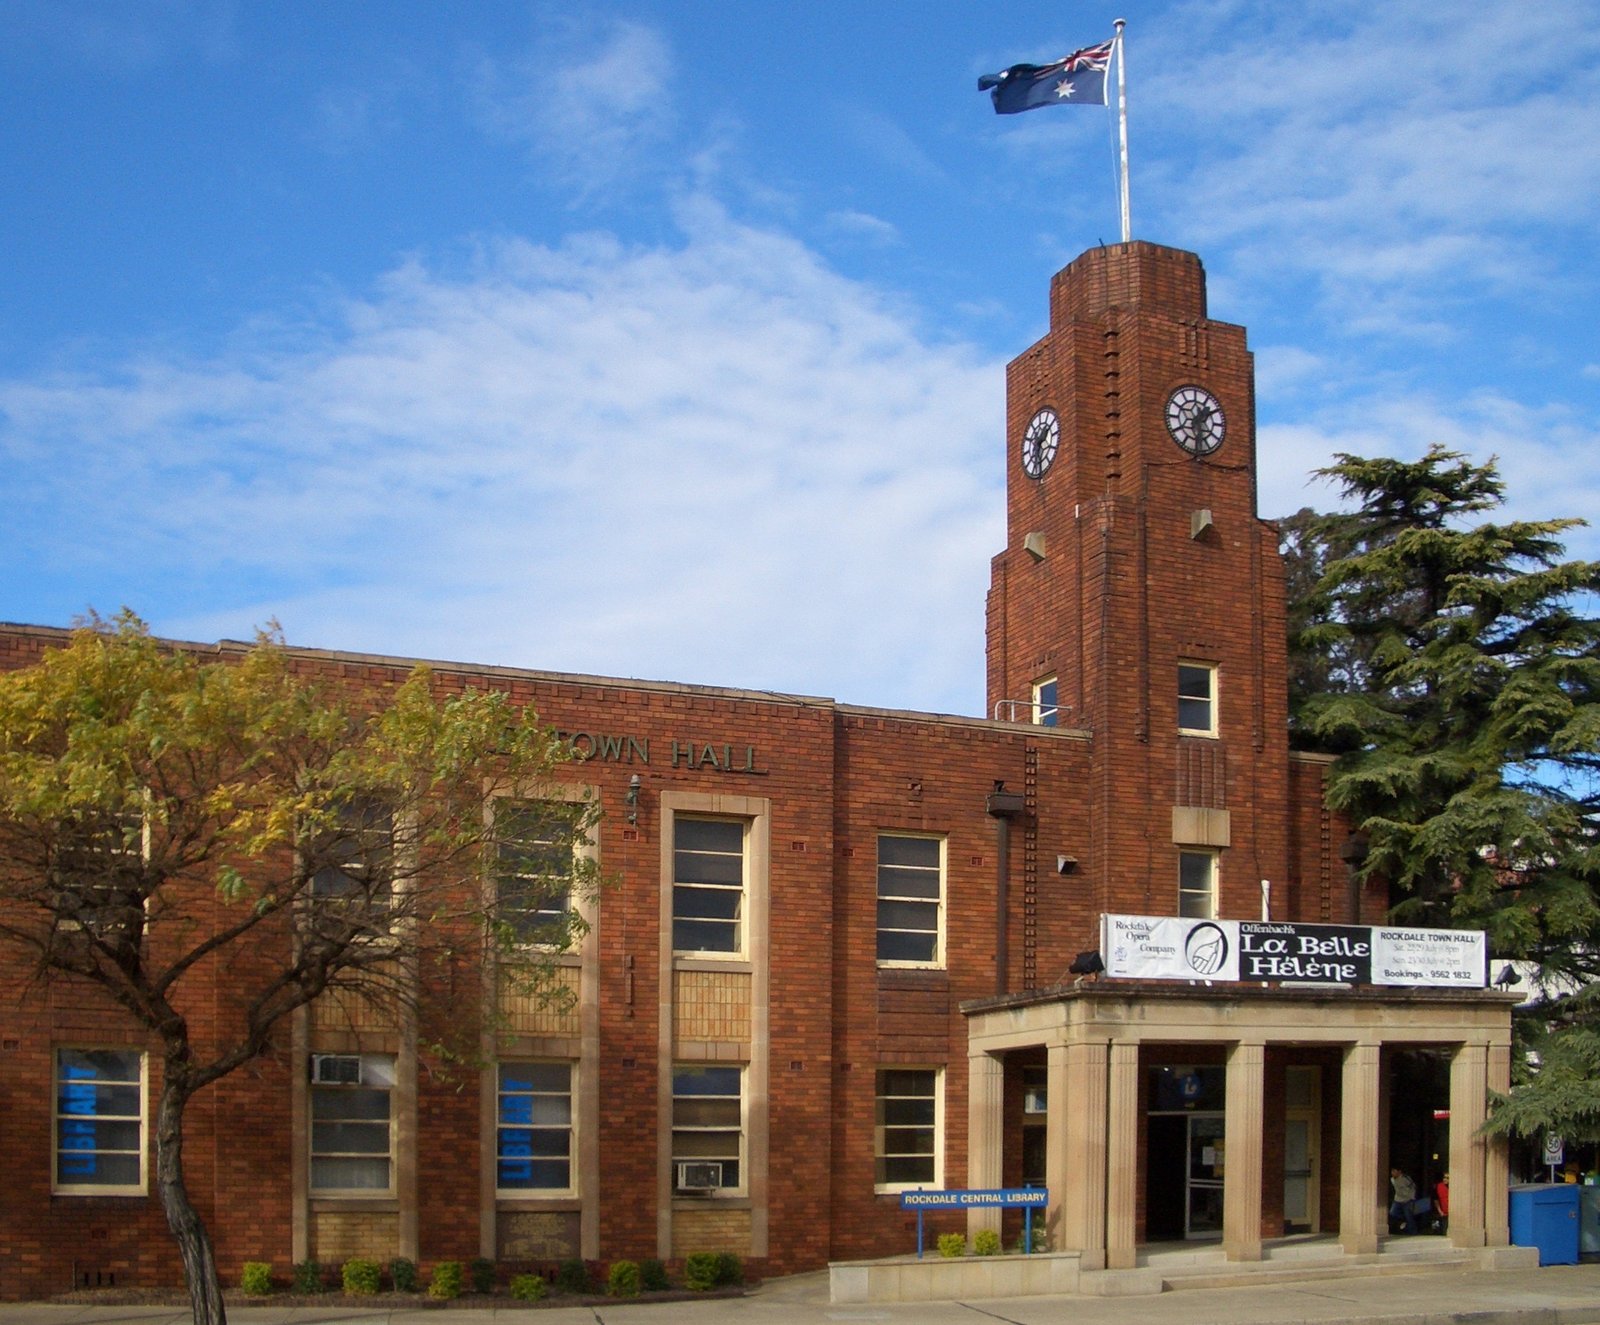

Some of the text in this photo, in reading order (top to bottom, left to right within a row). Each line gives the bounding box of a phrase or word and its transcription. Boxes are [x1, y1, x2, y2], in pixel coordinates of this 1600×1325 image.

[671, 738, 768, 775] HALL
[1115, 920, 1152, 932] Rockdale
[1241, 923, 1296, 935] Offenbach's
[1125, 931, 1151, 941] Opera
[1380, 931, 1475, 943] ROCKDALE TOWN HALL
[1140, 943, 1176, 955] Company
[1240, 934, 1370, 957] La Belle
[1384, 969, 1424, 979] Bookings
[1430, 970, 1450, 978] 9562
[1453, 971, 1472, 979] 1832
[63, 1065, 97, 1174] LIBRARY
[502, 1078, 533, 1180] LIBRARY
[1549, 1138, 1559, 1149] 50
[904, 1193, 1046, 1204] ROCKDALE CENTRAL LIBRARY
